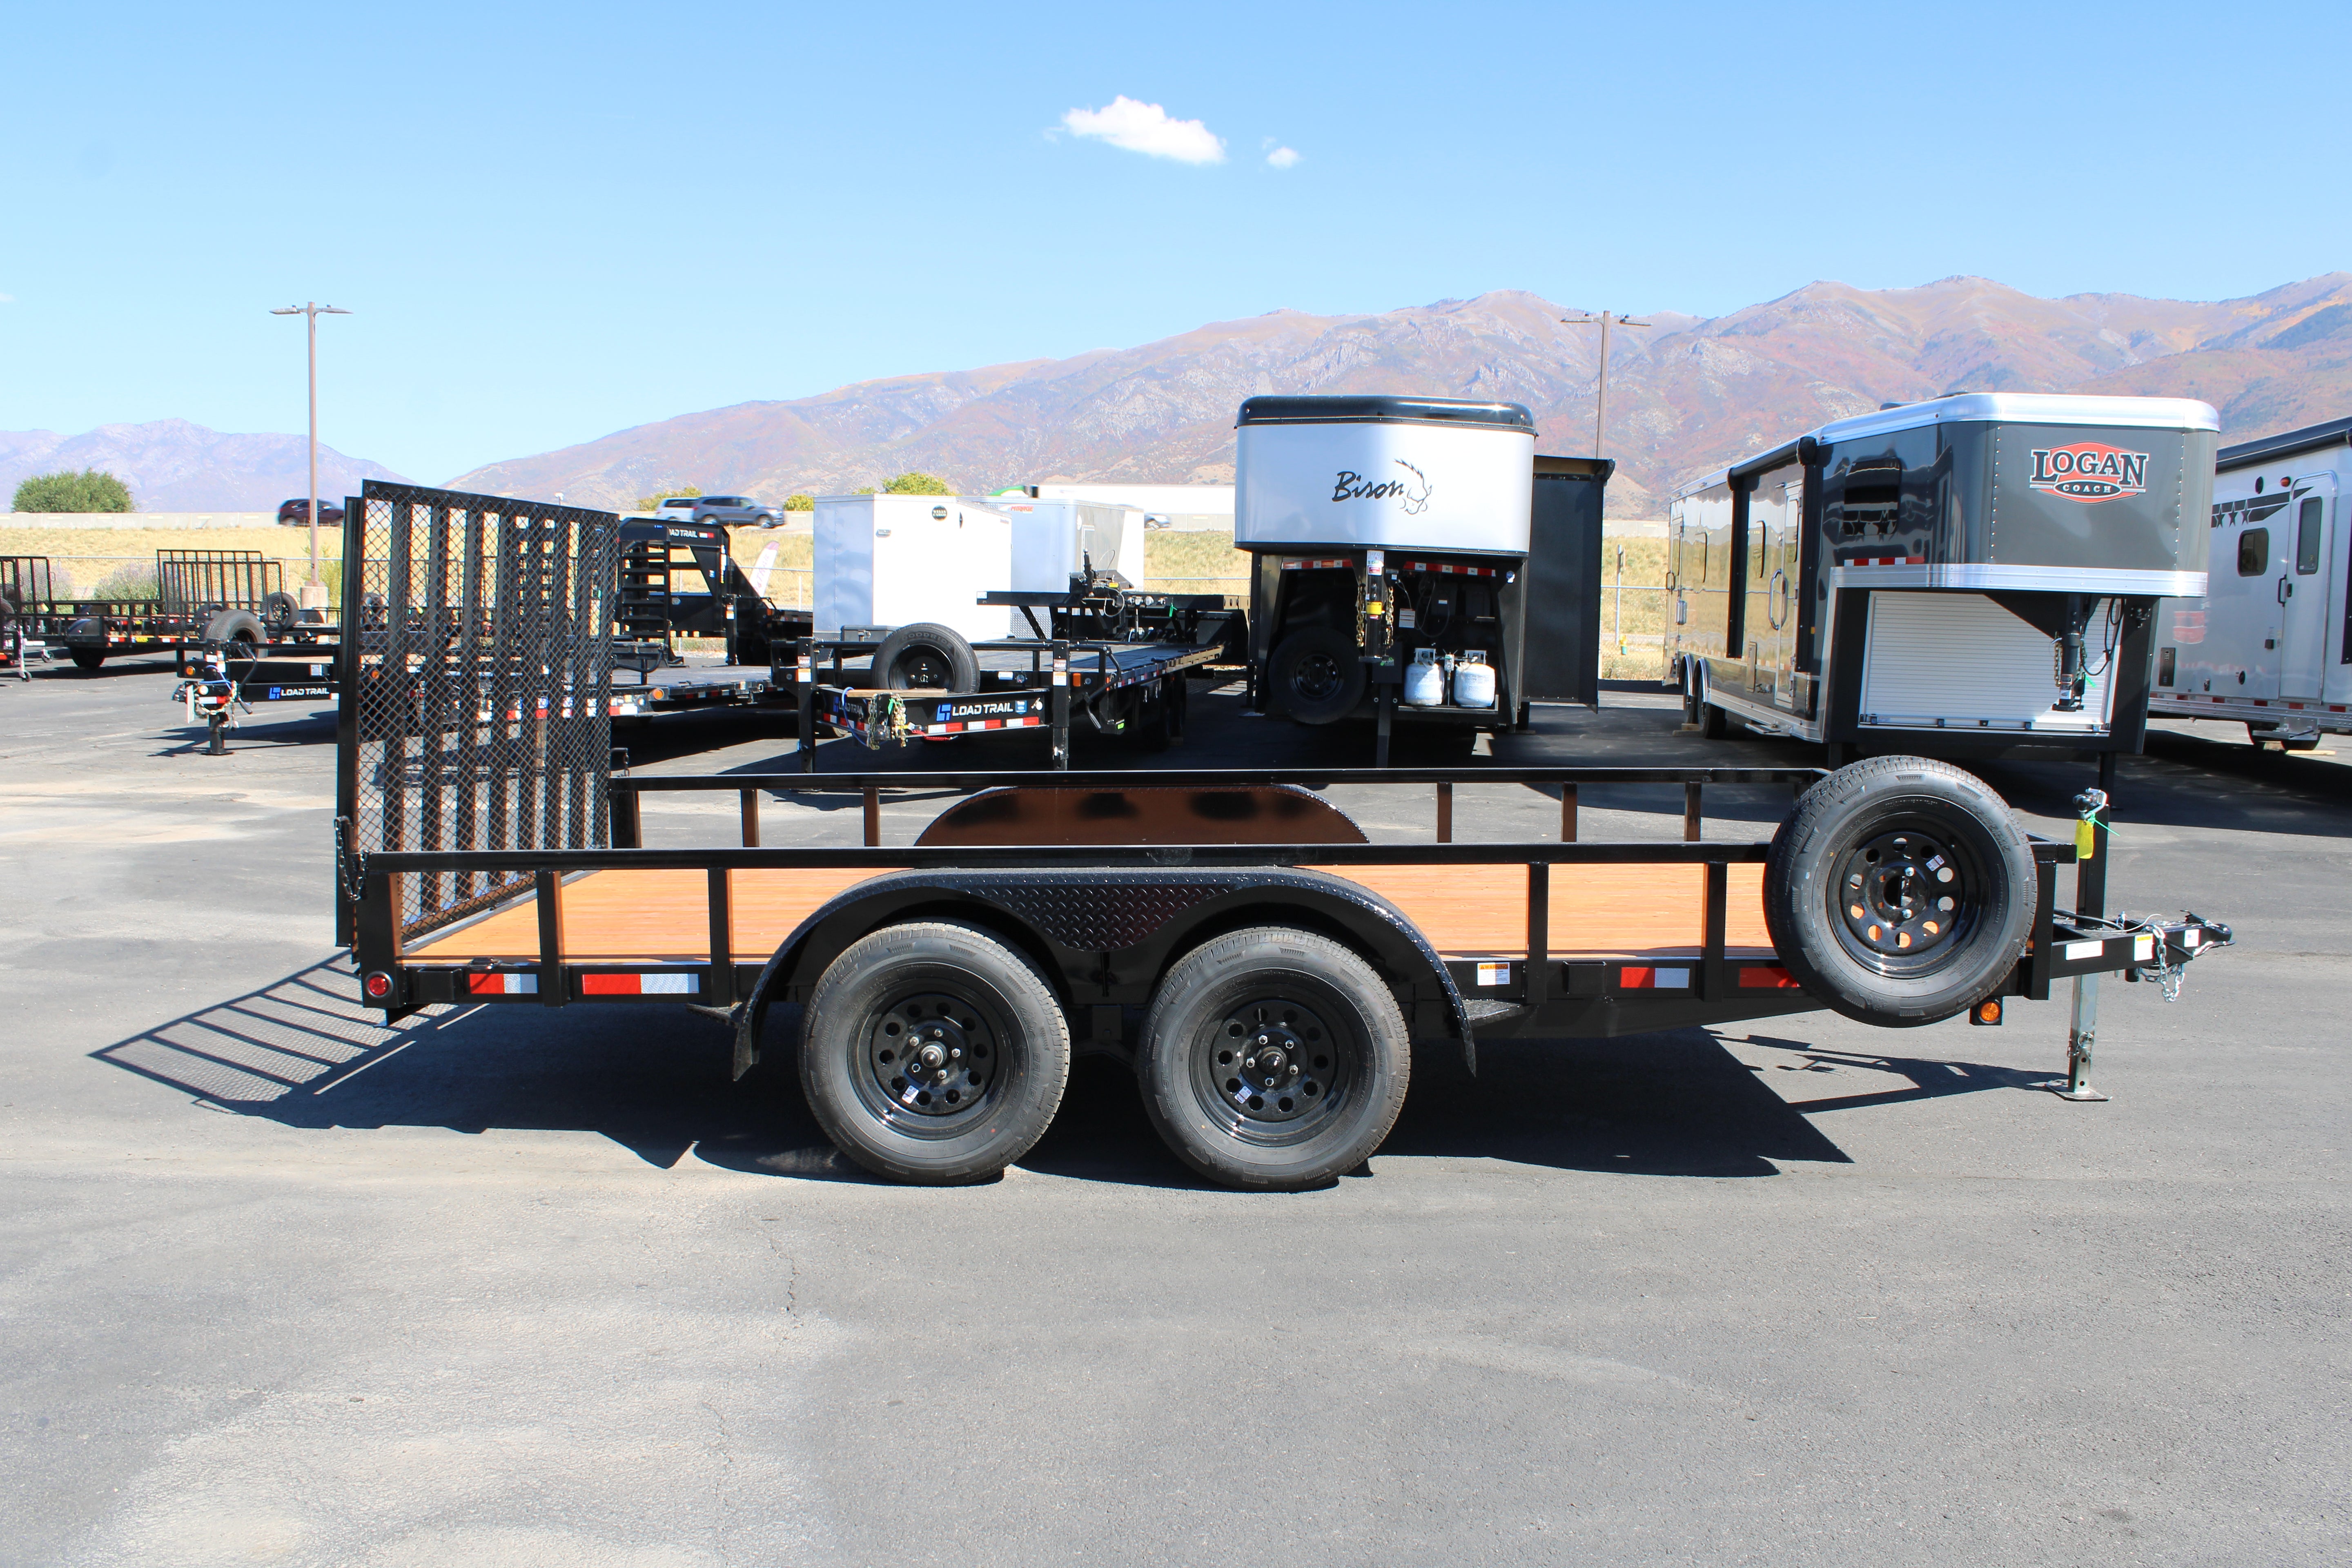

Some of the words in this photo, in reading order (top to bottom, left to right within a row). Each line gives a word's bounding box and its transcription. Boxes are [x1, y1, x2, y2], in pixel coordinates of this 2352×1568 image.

[2029, 449, 2149, 488] LOGAN
[1332, 471, 1404, 502] Bison
[2062, 484, 2111, 493] COACH
[668, 528, 679, 537] AD
[679, 529, 698, 538] TRAIL
[839, 701, 851, 711] LAD
[952, 705, 983, 716] LOAD
[983, 702, 1013, 714] TRAIL
[1803, 922, 1815, 938] ST
[1025, 1052, 1041, 1108] RAINIER
[1160, 1072, 1170, 1089] ST
